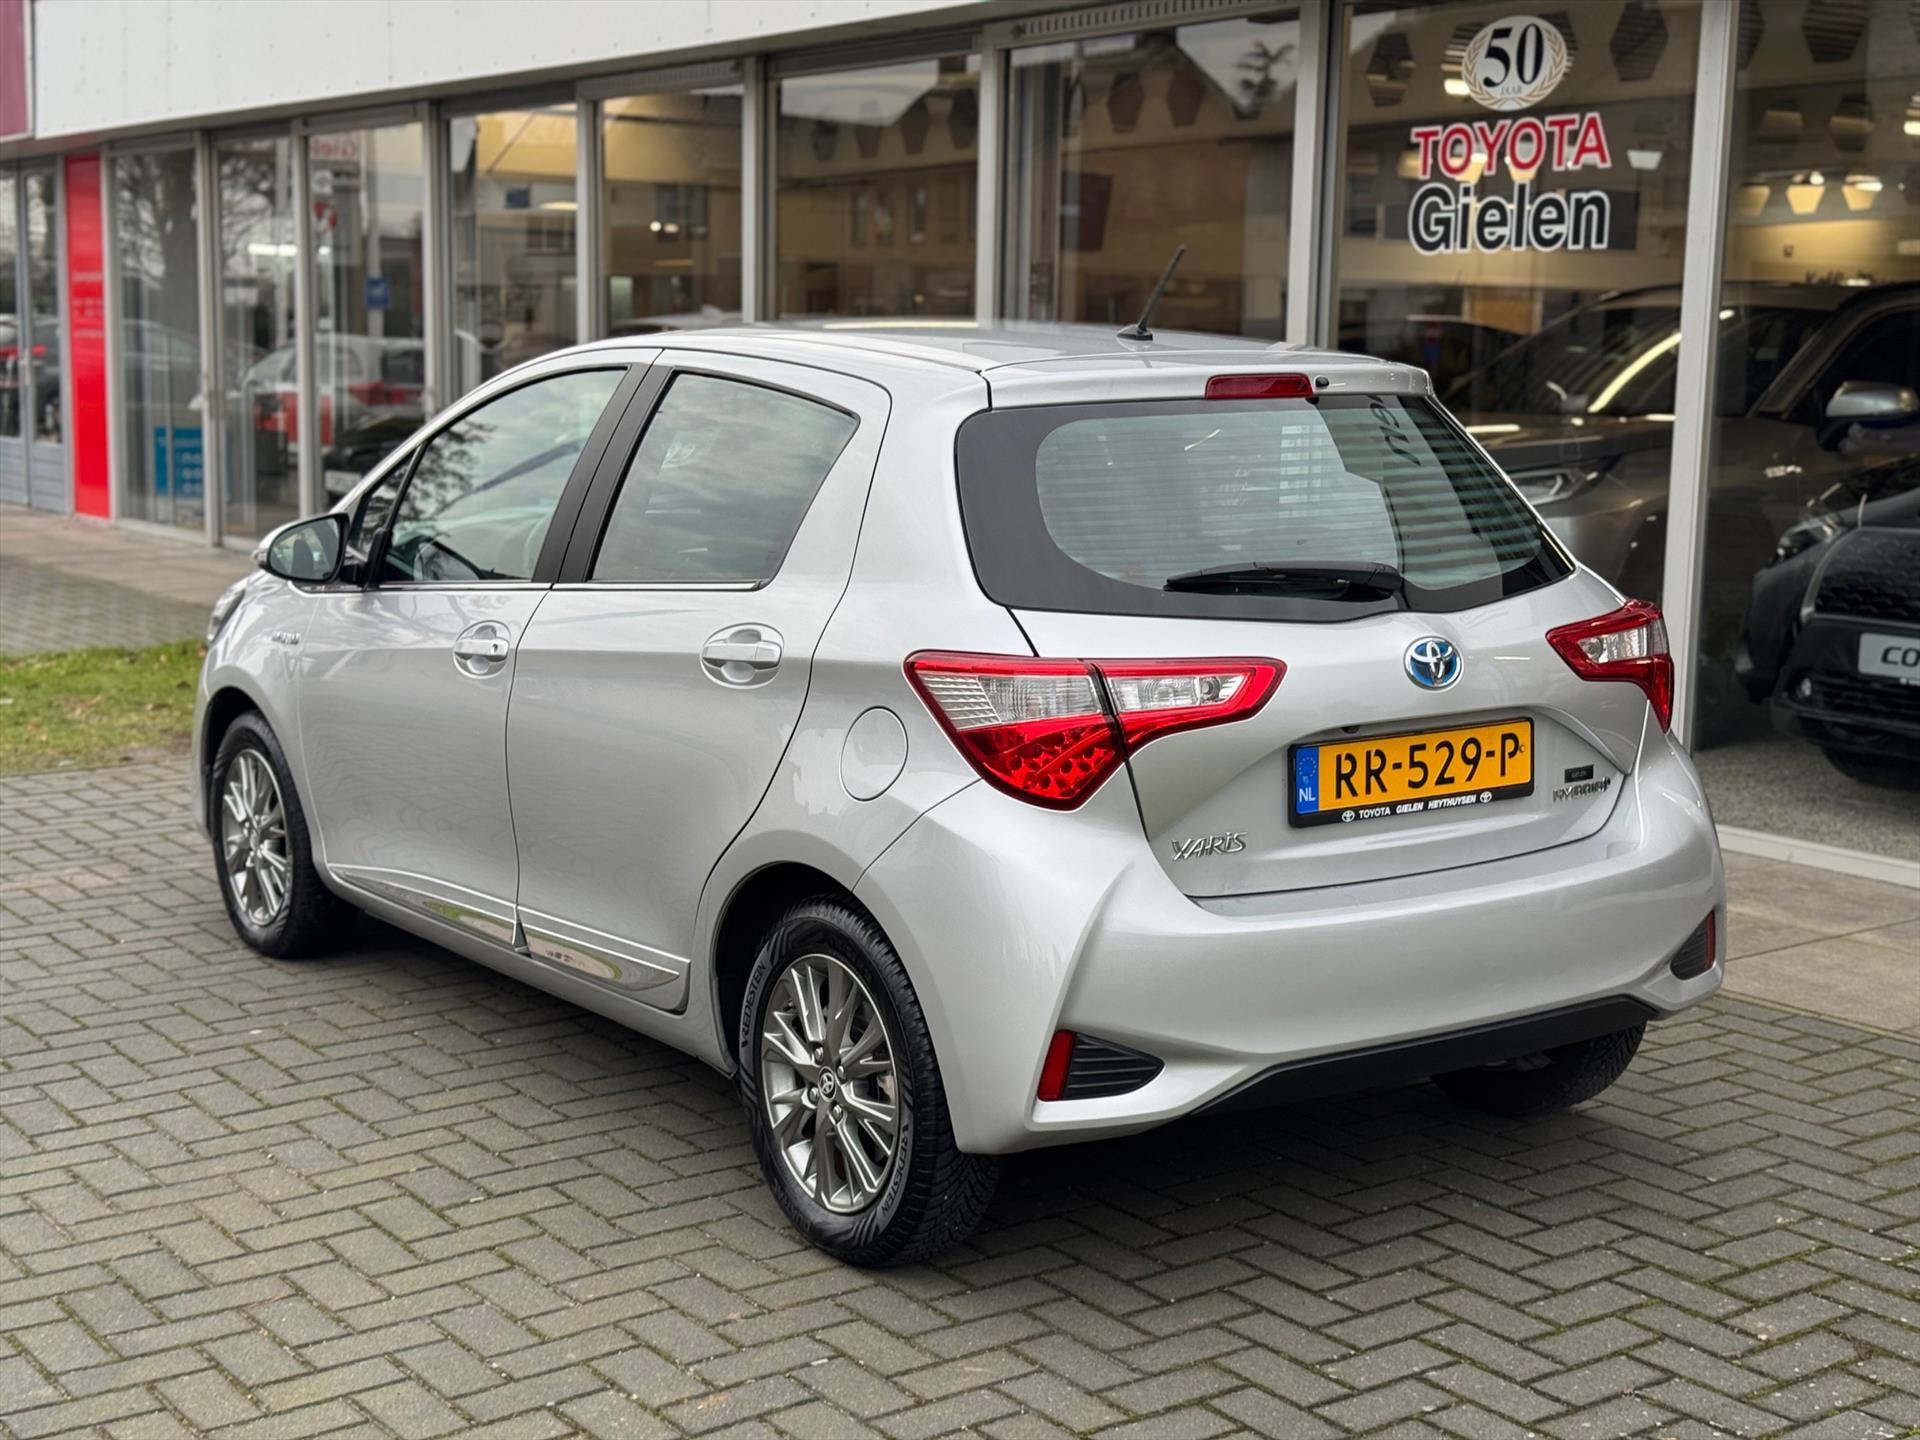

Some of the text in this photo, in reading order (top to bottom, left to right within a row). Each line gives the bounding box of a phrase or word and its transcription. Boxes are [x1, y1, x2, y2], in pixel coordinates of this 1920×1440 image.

[1483, 23, 1544, 87] 50
[1411, 112, 1612, 179] TOYOTA
[1408, 181, 1610, 256] Gielen
[1298, 787, 1316, 803] NL
[1335, 732, 1520, 799] RR-529-P
[1359, 795, 1477, 819] TOYOTA GIELEN HEYTHUYSEN
